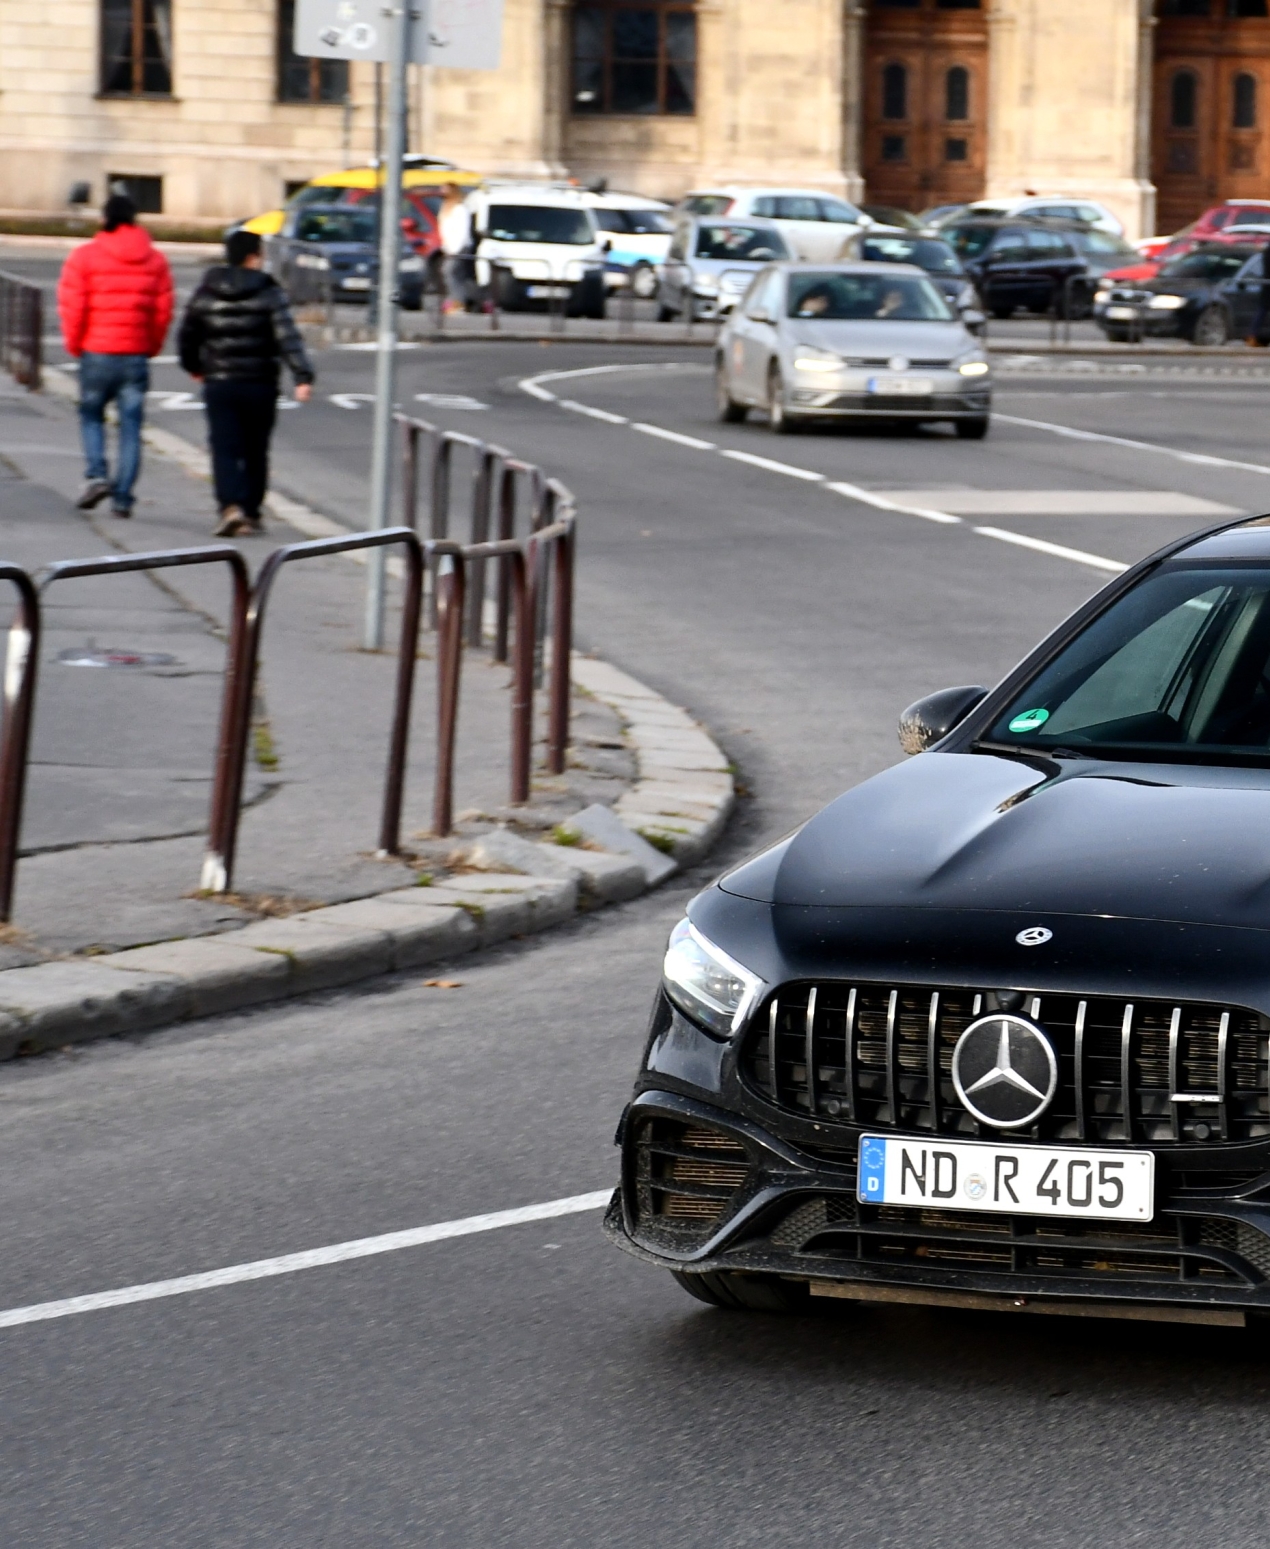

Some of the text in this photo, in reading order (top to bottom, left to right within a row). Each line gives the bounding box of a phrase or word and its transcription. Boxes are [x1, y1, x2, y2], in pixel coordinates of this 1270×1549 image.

[867, 1176, 879, 1192] D
[900, 1147, 1125, 1209] ND R 405
